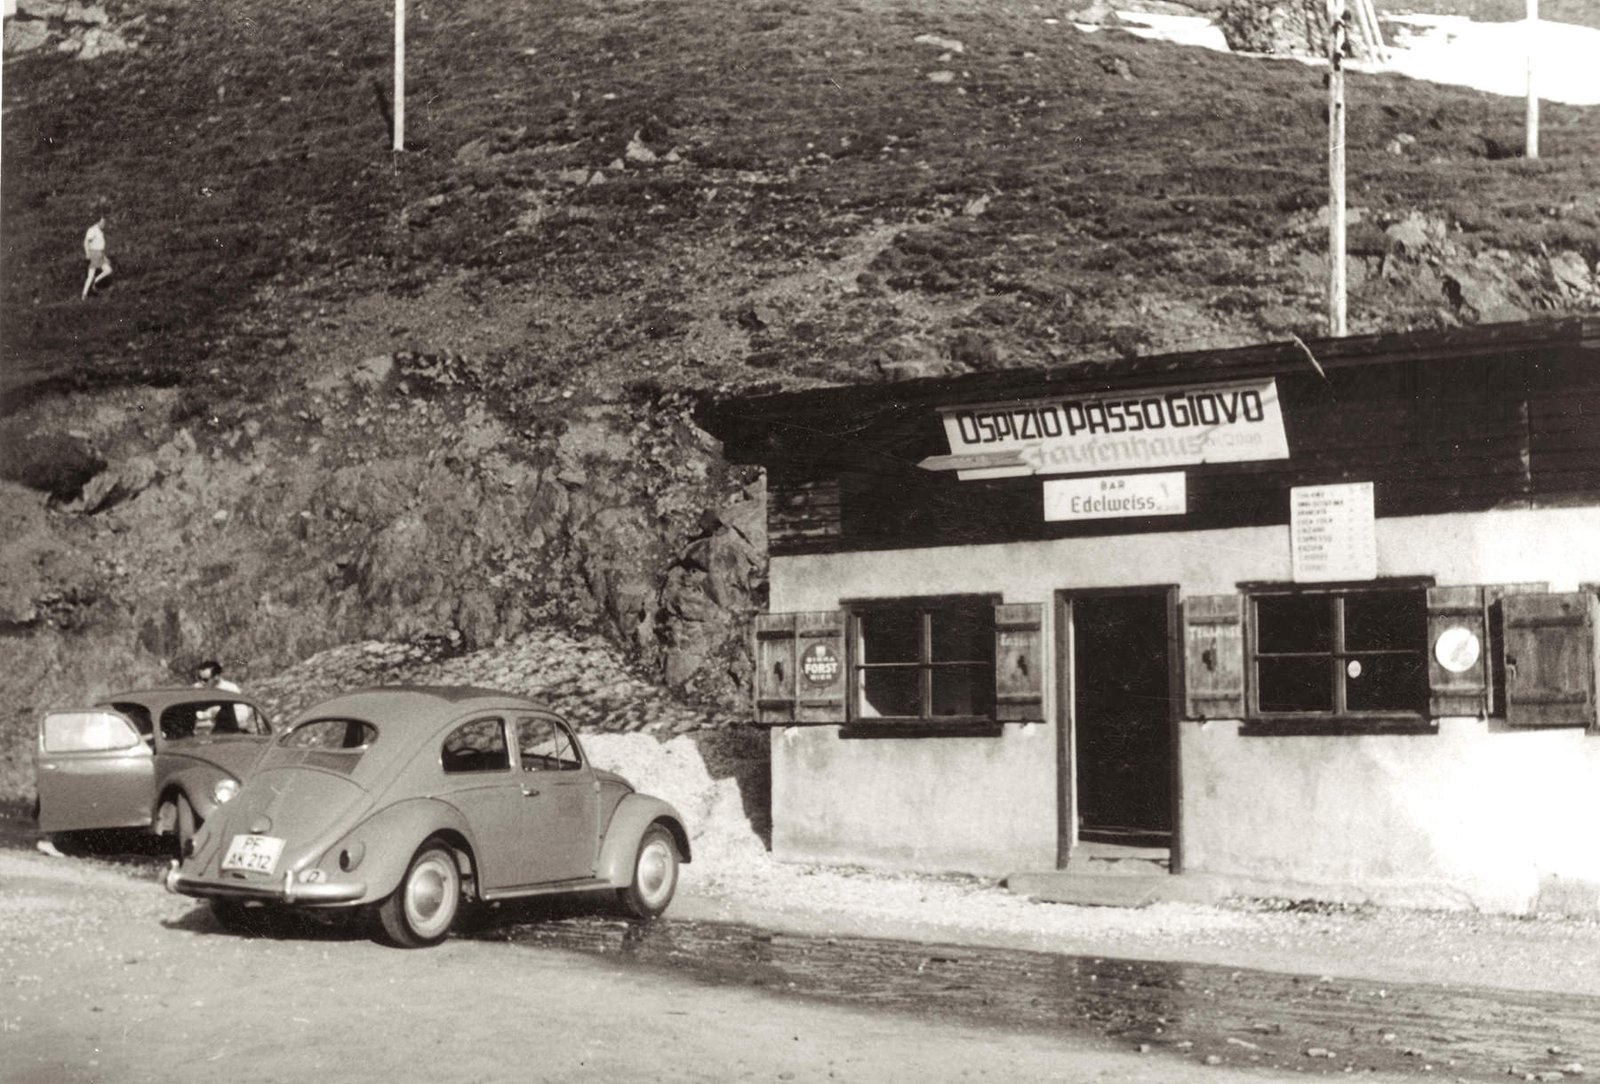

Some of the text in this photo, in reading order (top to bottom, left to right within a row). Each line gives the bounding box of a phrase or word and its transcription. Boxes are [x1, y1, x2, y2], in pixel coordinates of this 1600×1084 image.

[1063, 399, 1165, 435] PASSO
[1166, 389, 1265, 429] GIOVO
[1100, 480, 1126, 491] BAR
[1071, 494, 1156, 514] Edelweiss
[804, 662, 838, 675] FORST
[243, 836, 264, 850] PF
